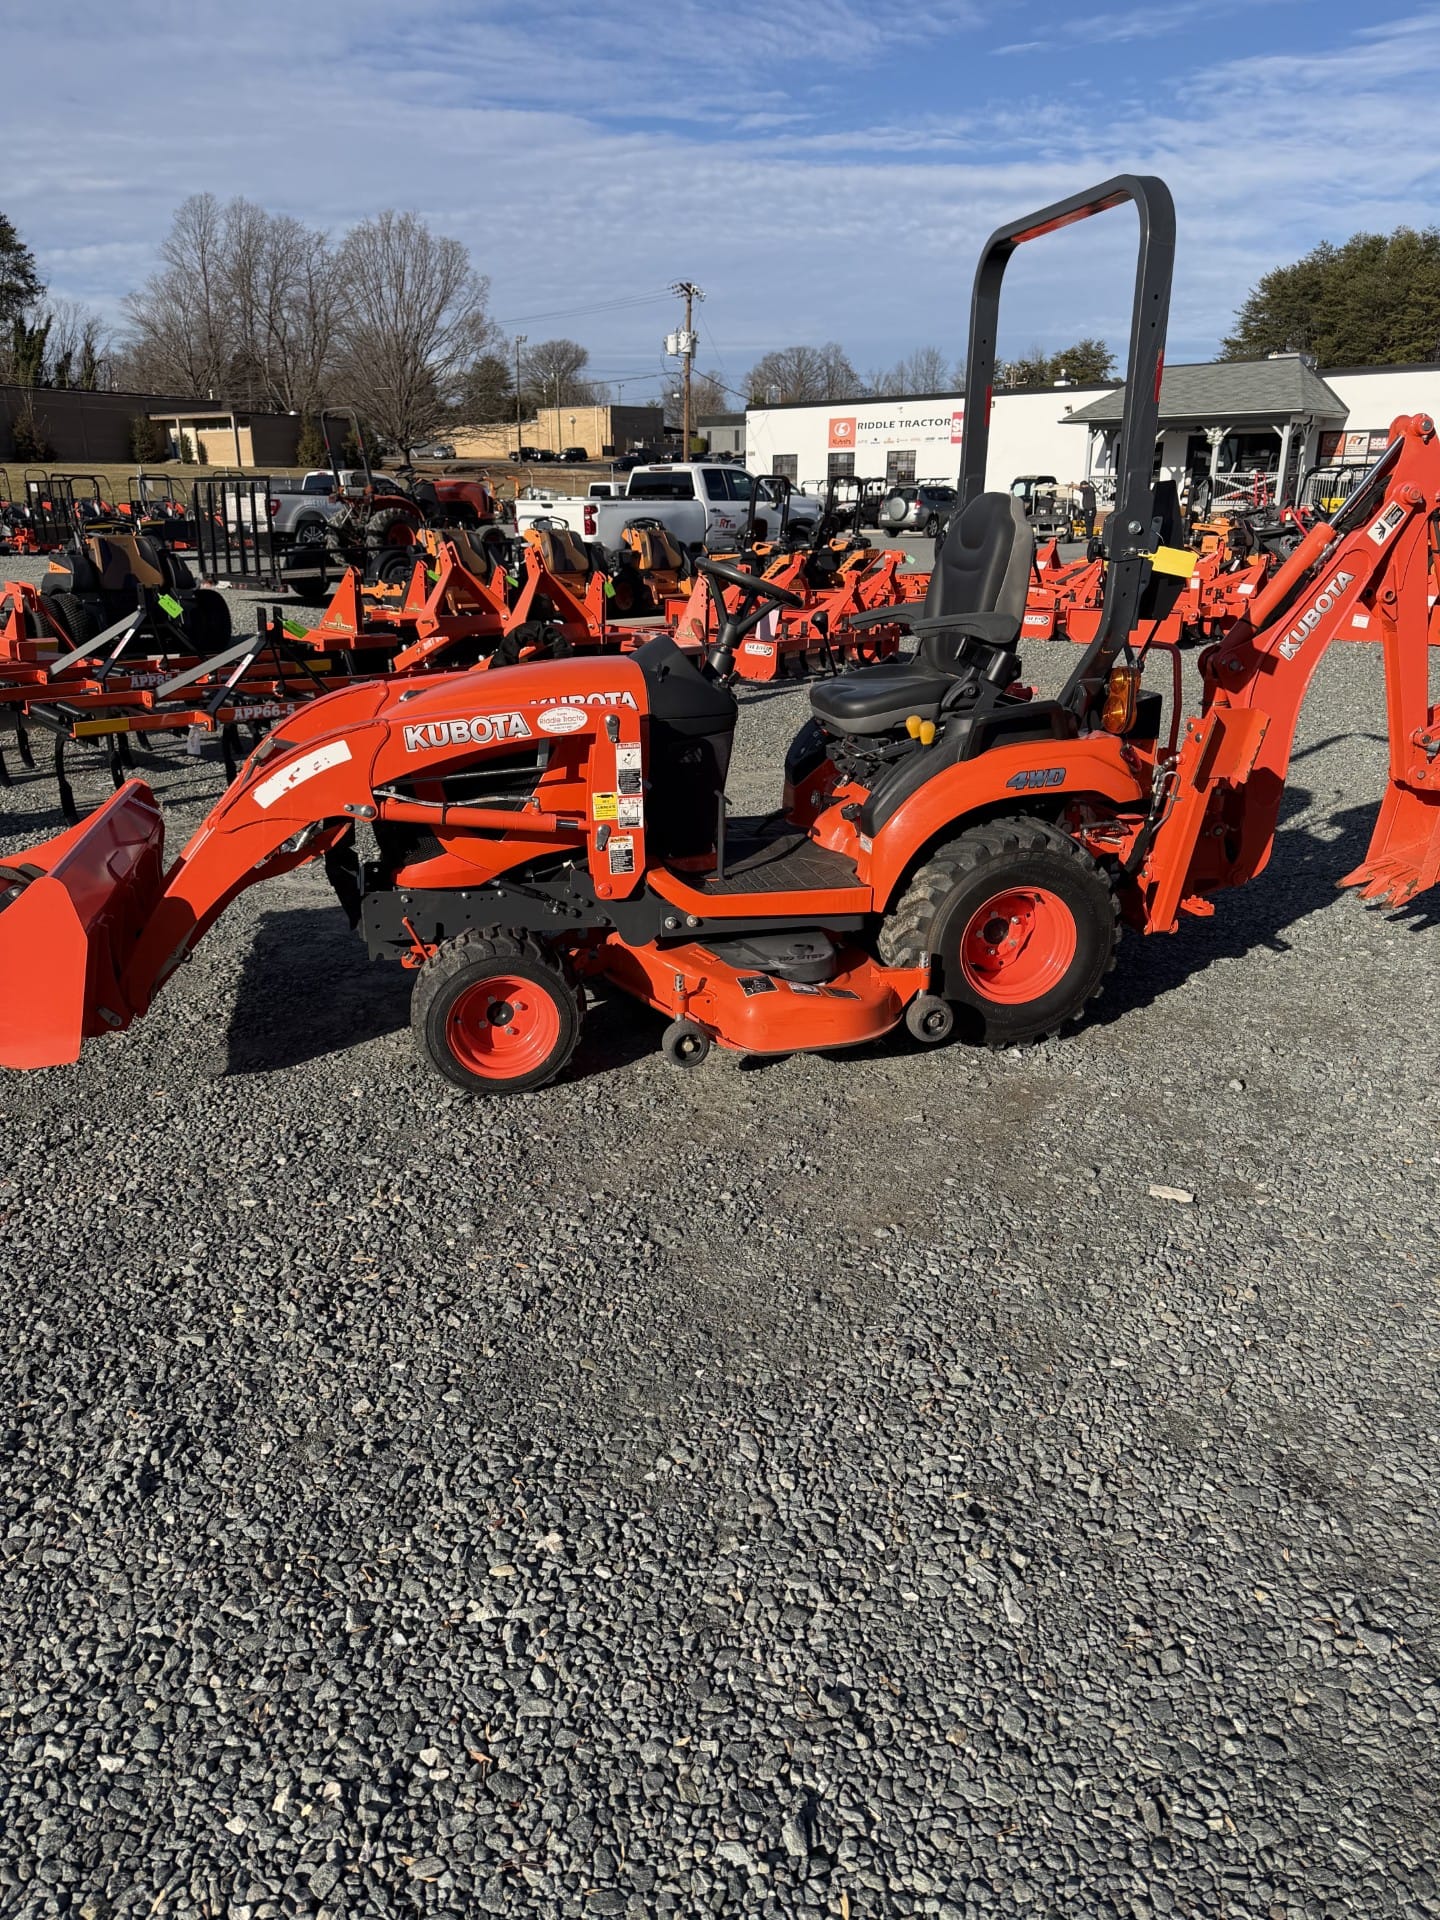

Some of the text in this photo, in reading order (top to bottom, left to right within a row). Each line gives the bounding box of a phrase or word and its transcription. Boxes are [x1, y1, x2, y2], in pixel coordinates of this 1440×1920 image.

[857, 418, 952, 430] RIDDLE TRACTOR
[1278, 570, 1356, 661] KUBOTA
[539, 714, 585, 724] Riddle Tractor
[404, 712, 532, 752] KUBOTA
[1005, 767, 1067, 791] 4WD
